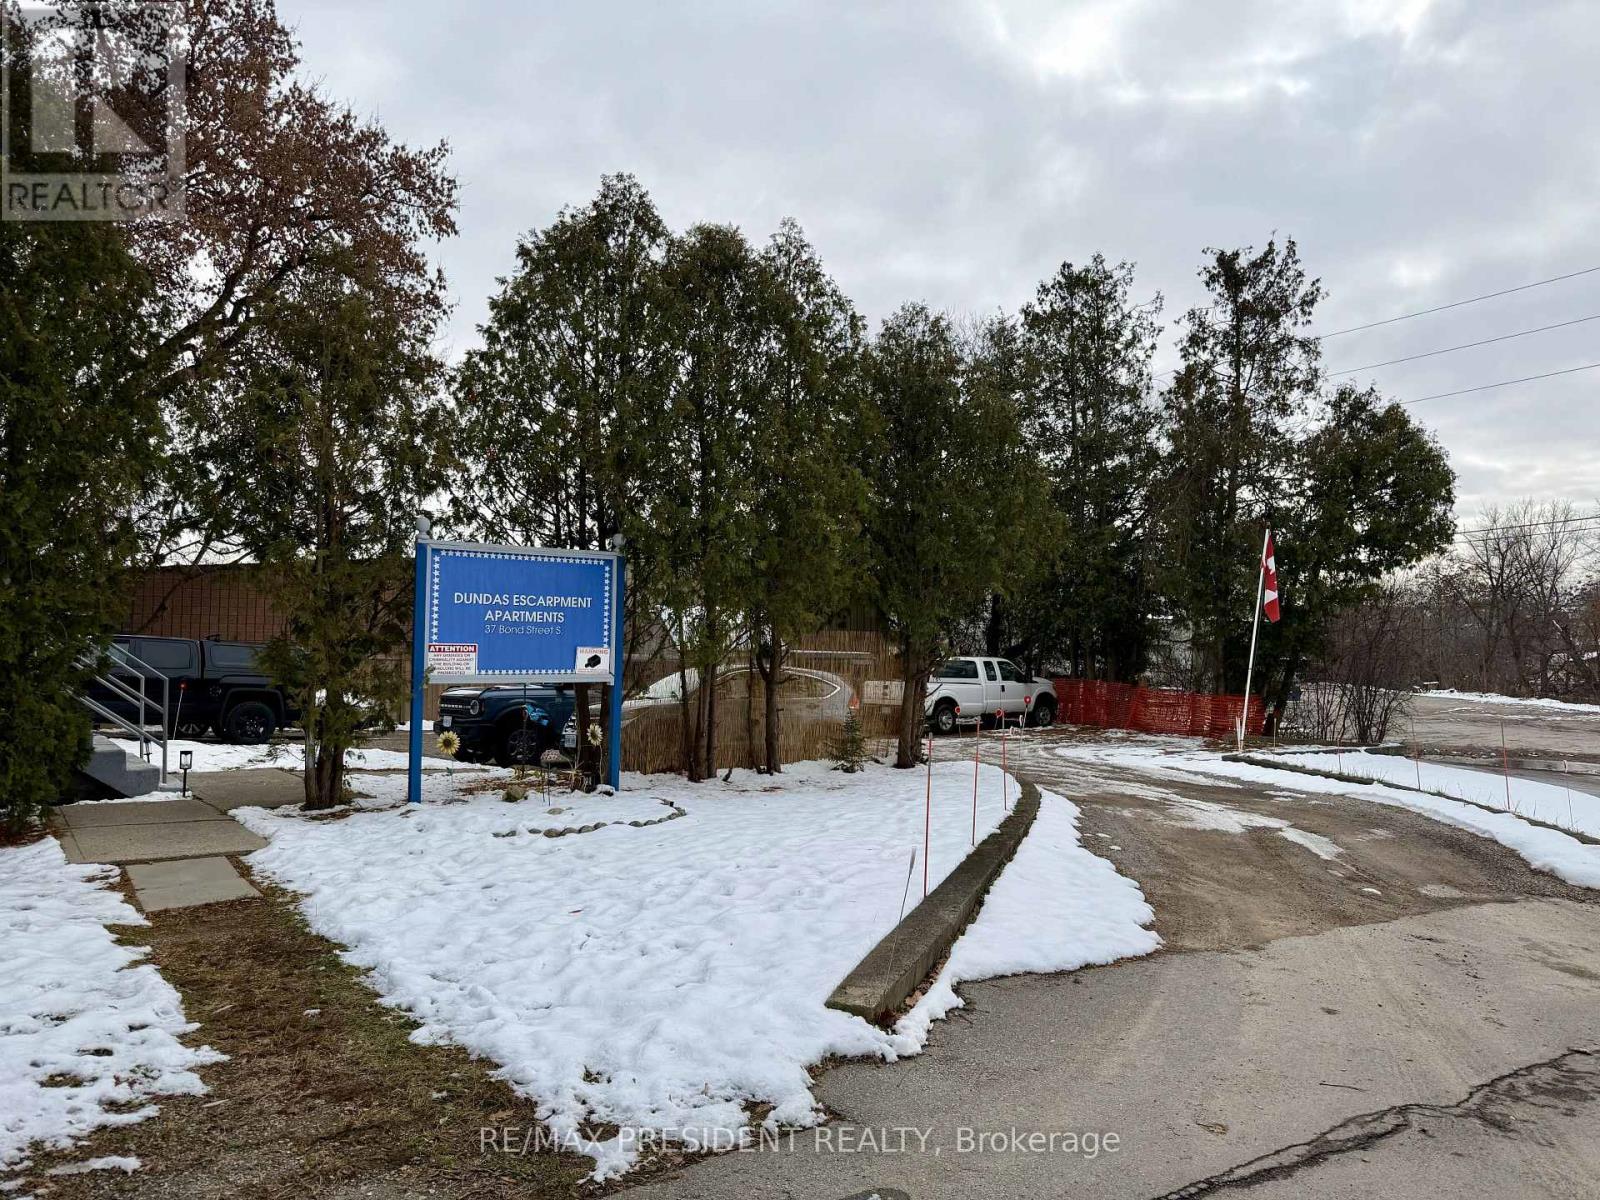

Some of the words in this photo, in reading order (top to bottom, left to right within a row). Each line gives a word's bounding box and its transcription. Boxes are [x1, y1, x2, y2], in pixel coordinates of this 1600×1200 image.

[454, 592, 510, 606] DUNDAS
[513, 594, 592, 608] ESCARPMENT
[484, 610, 565, 623] APARTMENTS
[484, 624, 496, 634] 37
[499, 626, 524, 634] Bond
[526, 626, 554, 634] Street
[556, 626, 561, 634] S
